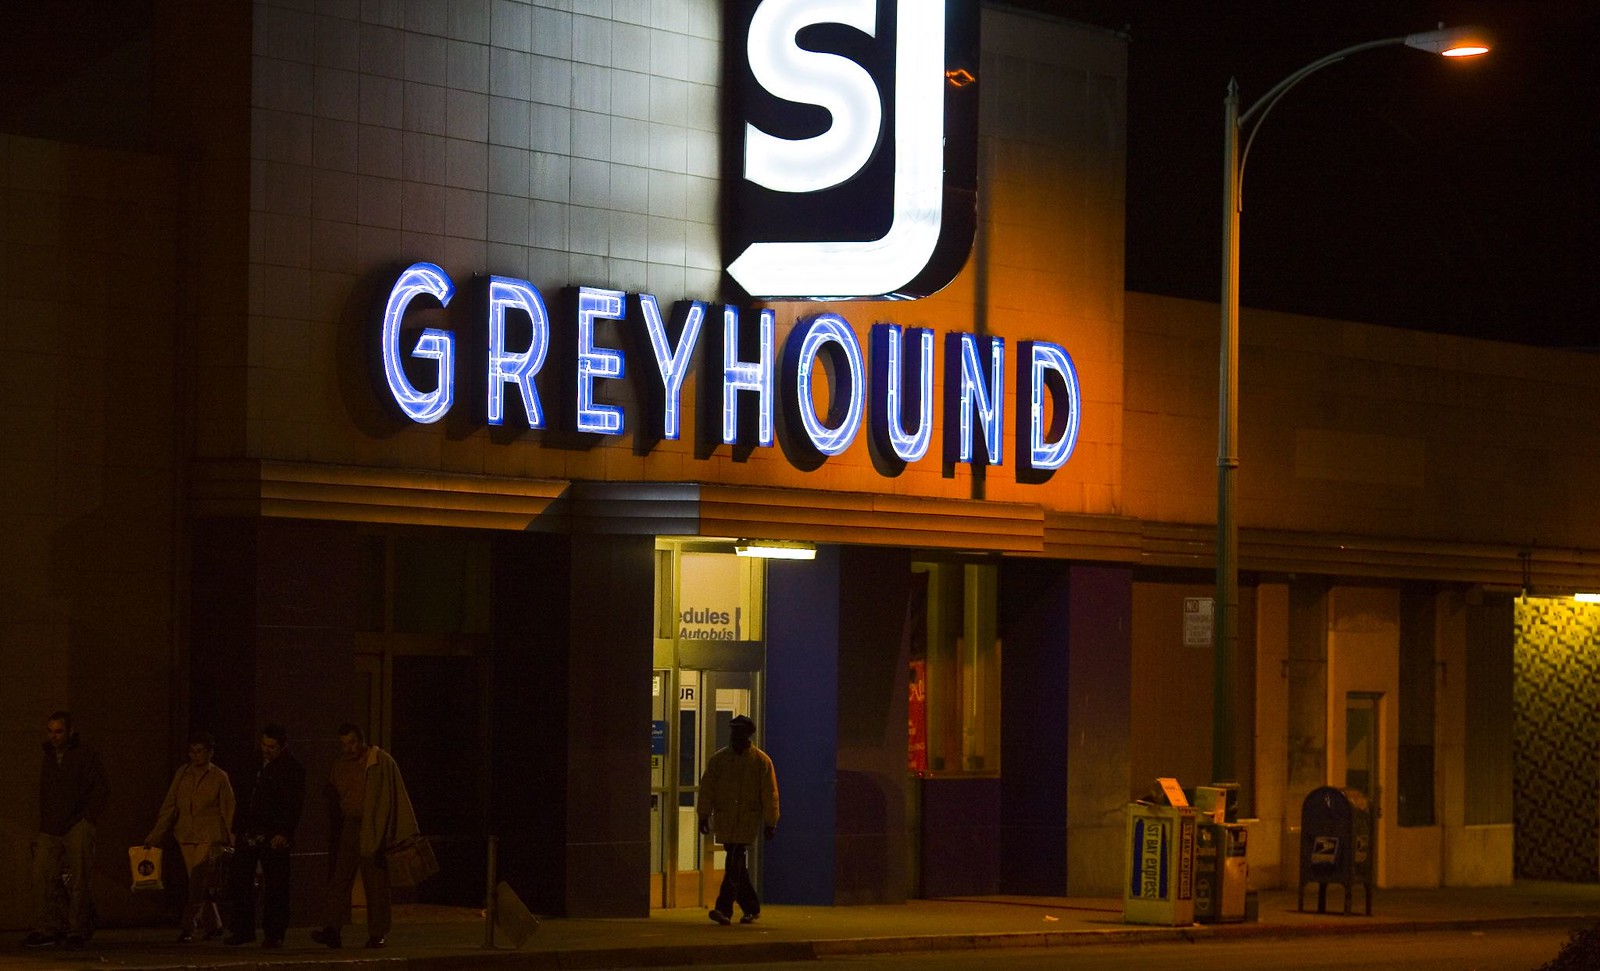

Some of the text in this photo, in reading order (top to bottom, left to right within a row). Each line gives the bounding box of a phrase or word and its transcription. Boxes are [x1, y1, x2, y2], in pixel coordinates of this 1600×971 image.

[380, 261, 1082, 472] GREYHOUND
[680, 627, 734, 641] Autobús
[1146, 839, 1158, 855] BAY
